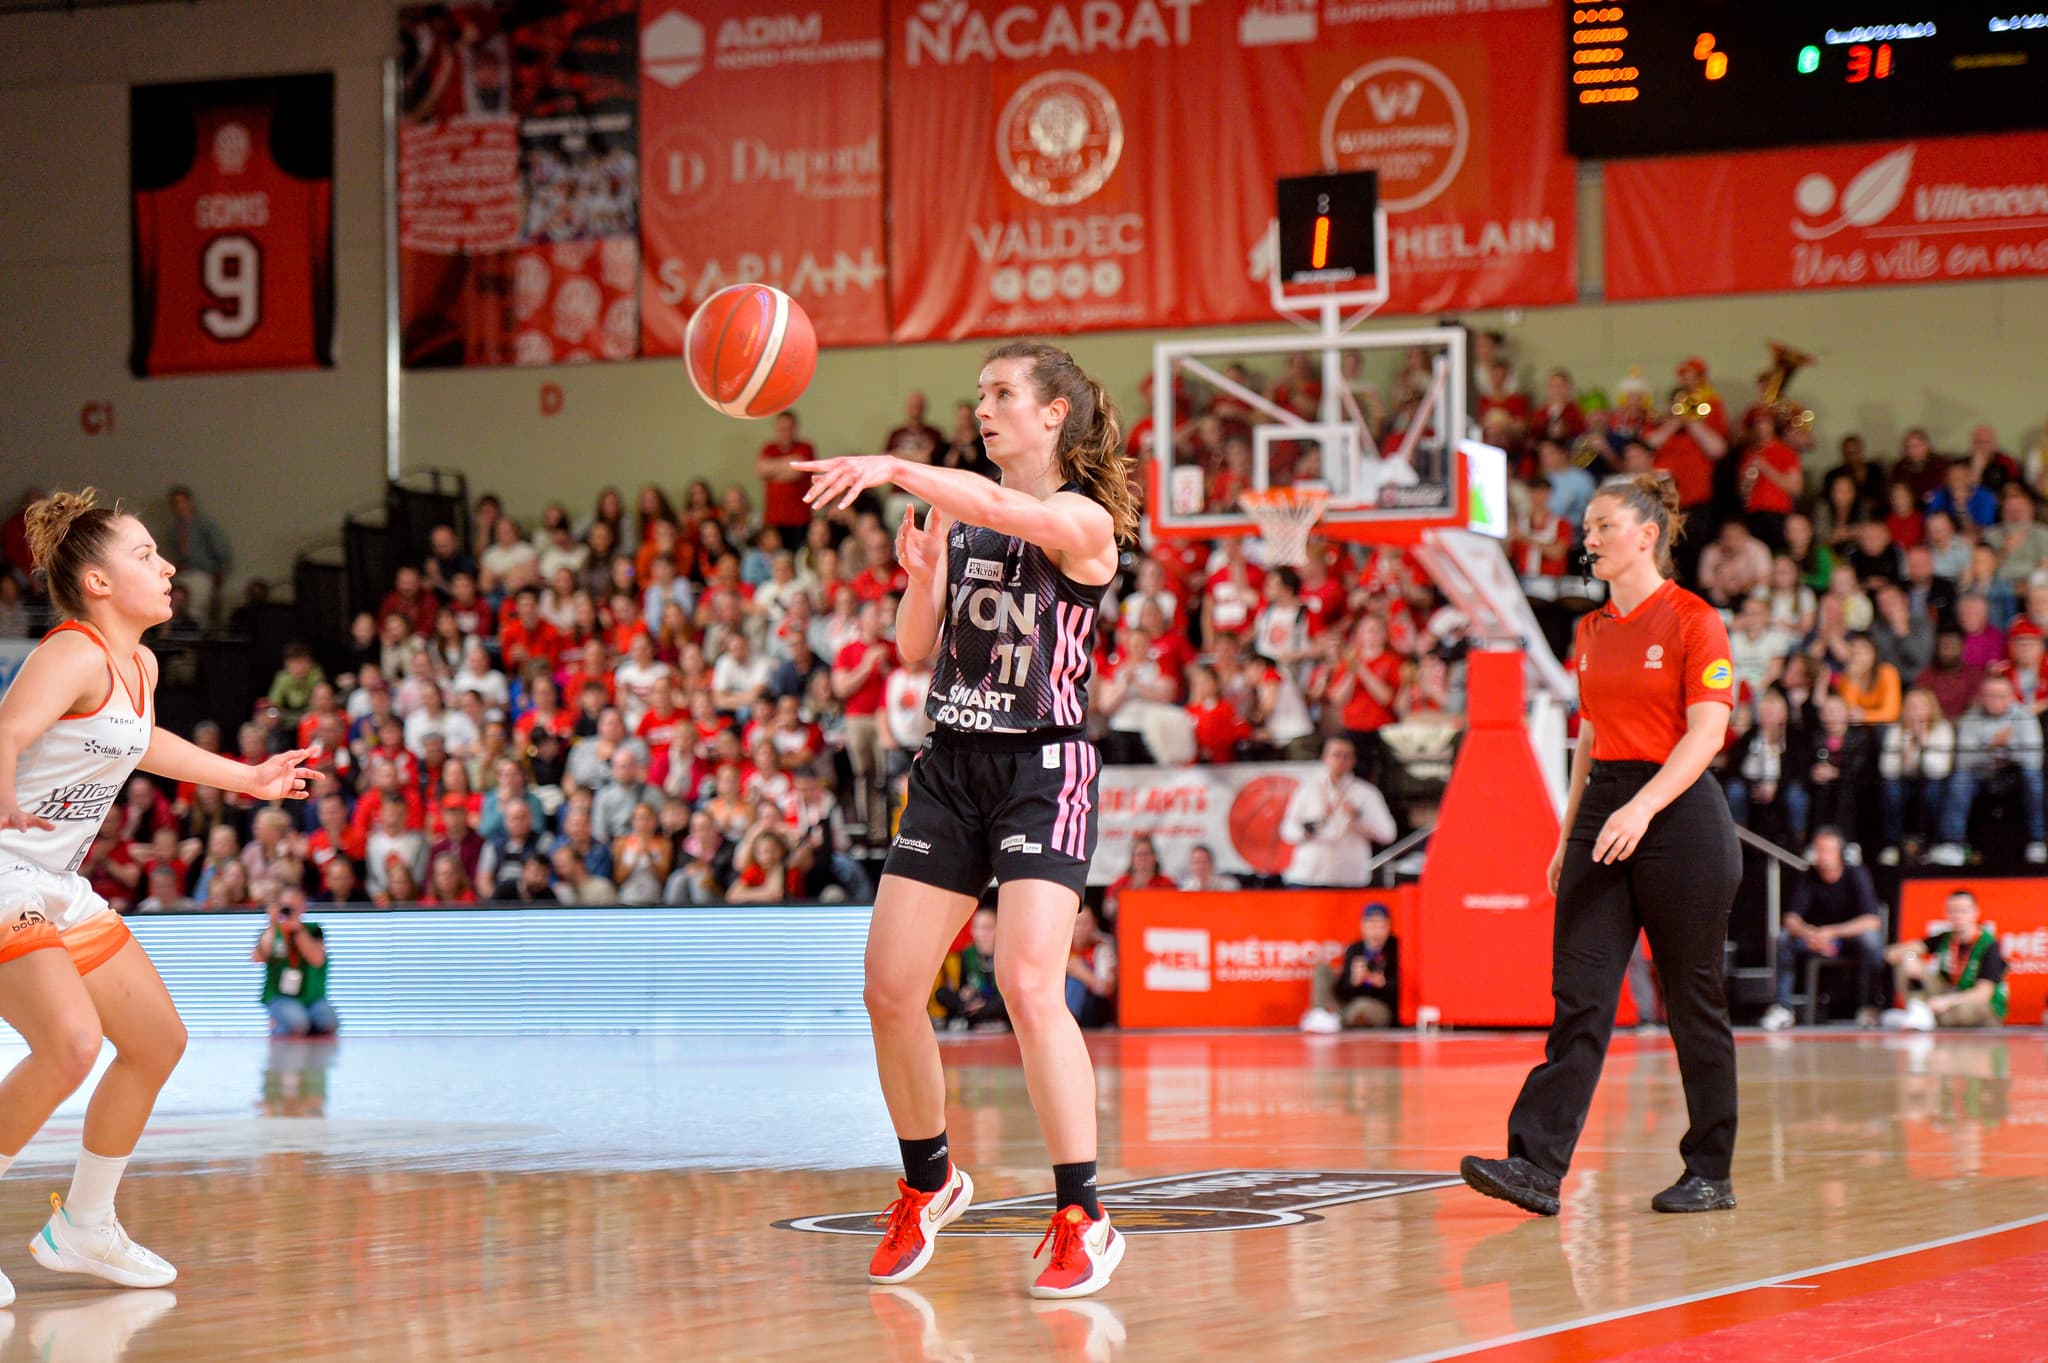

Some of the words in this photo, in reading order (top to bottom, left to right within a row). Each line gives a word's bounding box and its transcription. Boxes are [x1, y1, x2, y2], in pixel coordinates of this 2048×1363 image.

[715, 12, 823, 49] ADIM
[970, 213, 1144, 262] VALDEC
[204, 235, 260, 339] 9
[998, 643, 1033, 687] 11
[936, 704, 993, 730] GOOD
[949, 685, 1016, 713] SMART
